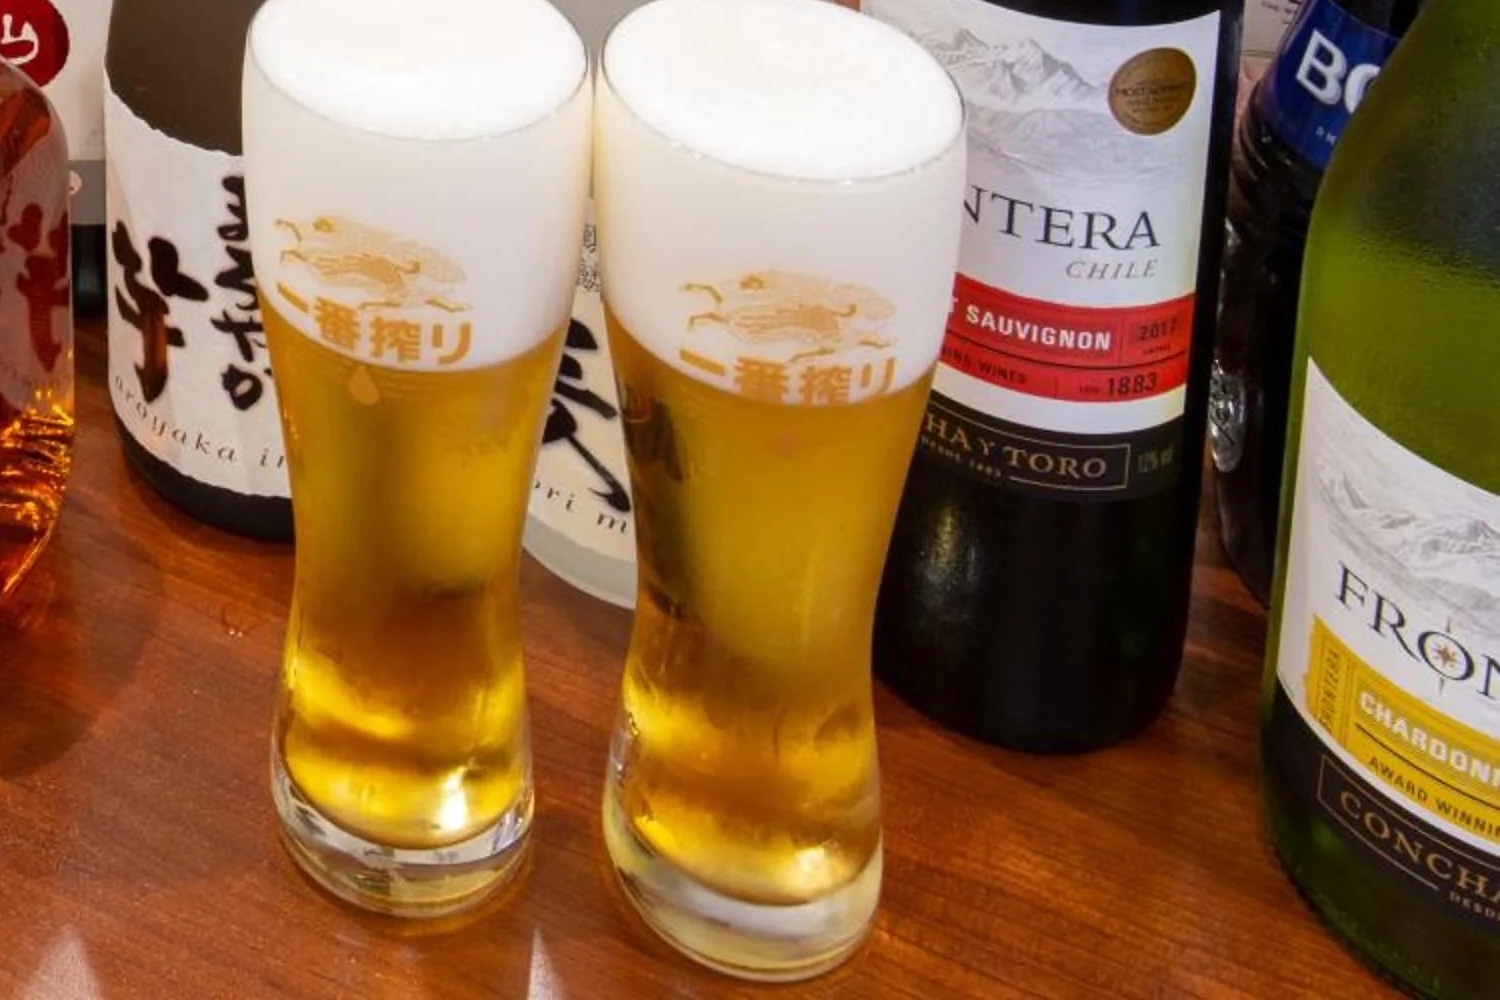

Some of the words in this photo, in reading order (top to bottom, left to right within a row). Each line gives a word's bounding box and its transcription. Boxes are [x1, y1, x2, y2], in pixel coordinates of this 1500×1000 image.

[1065, 258, 1159, 281] CHILE
[276, 280, 473, 365] 一番搾り
[965, 304, 1112, 352] SAUVIGNON
[1106, 371, 1159, 397] 1883
[1002, 445, 1108, 481] TORO
[1368, 755, 1429, 803] AWARD
